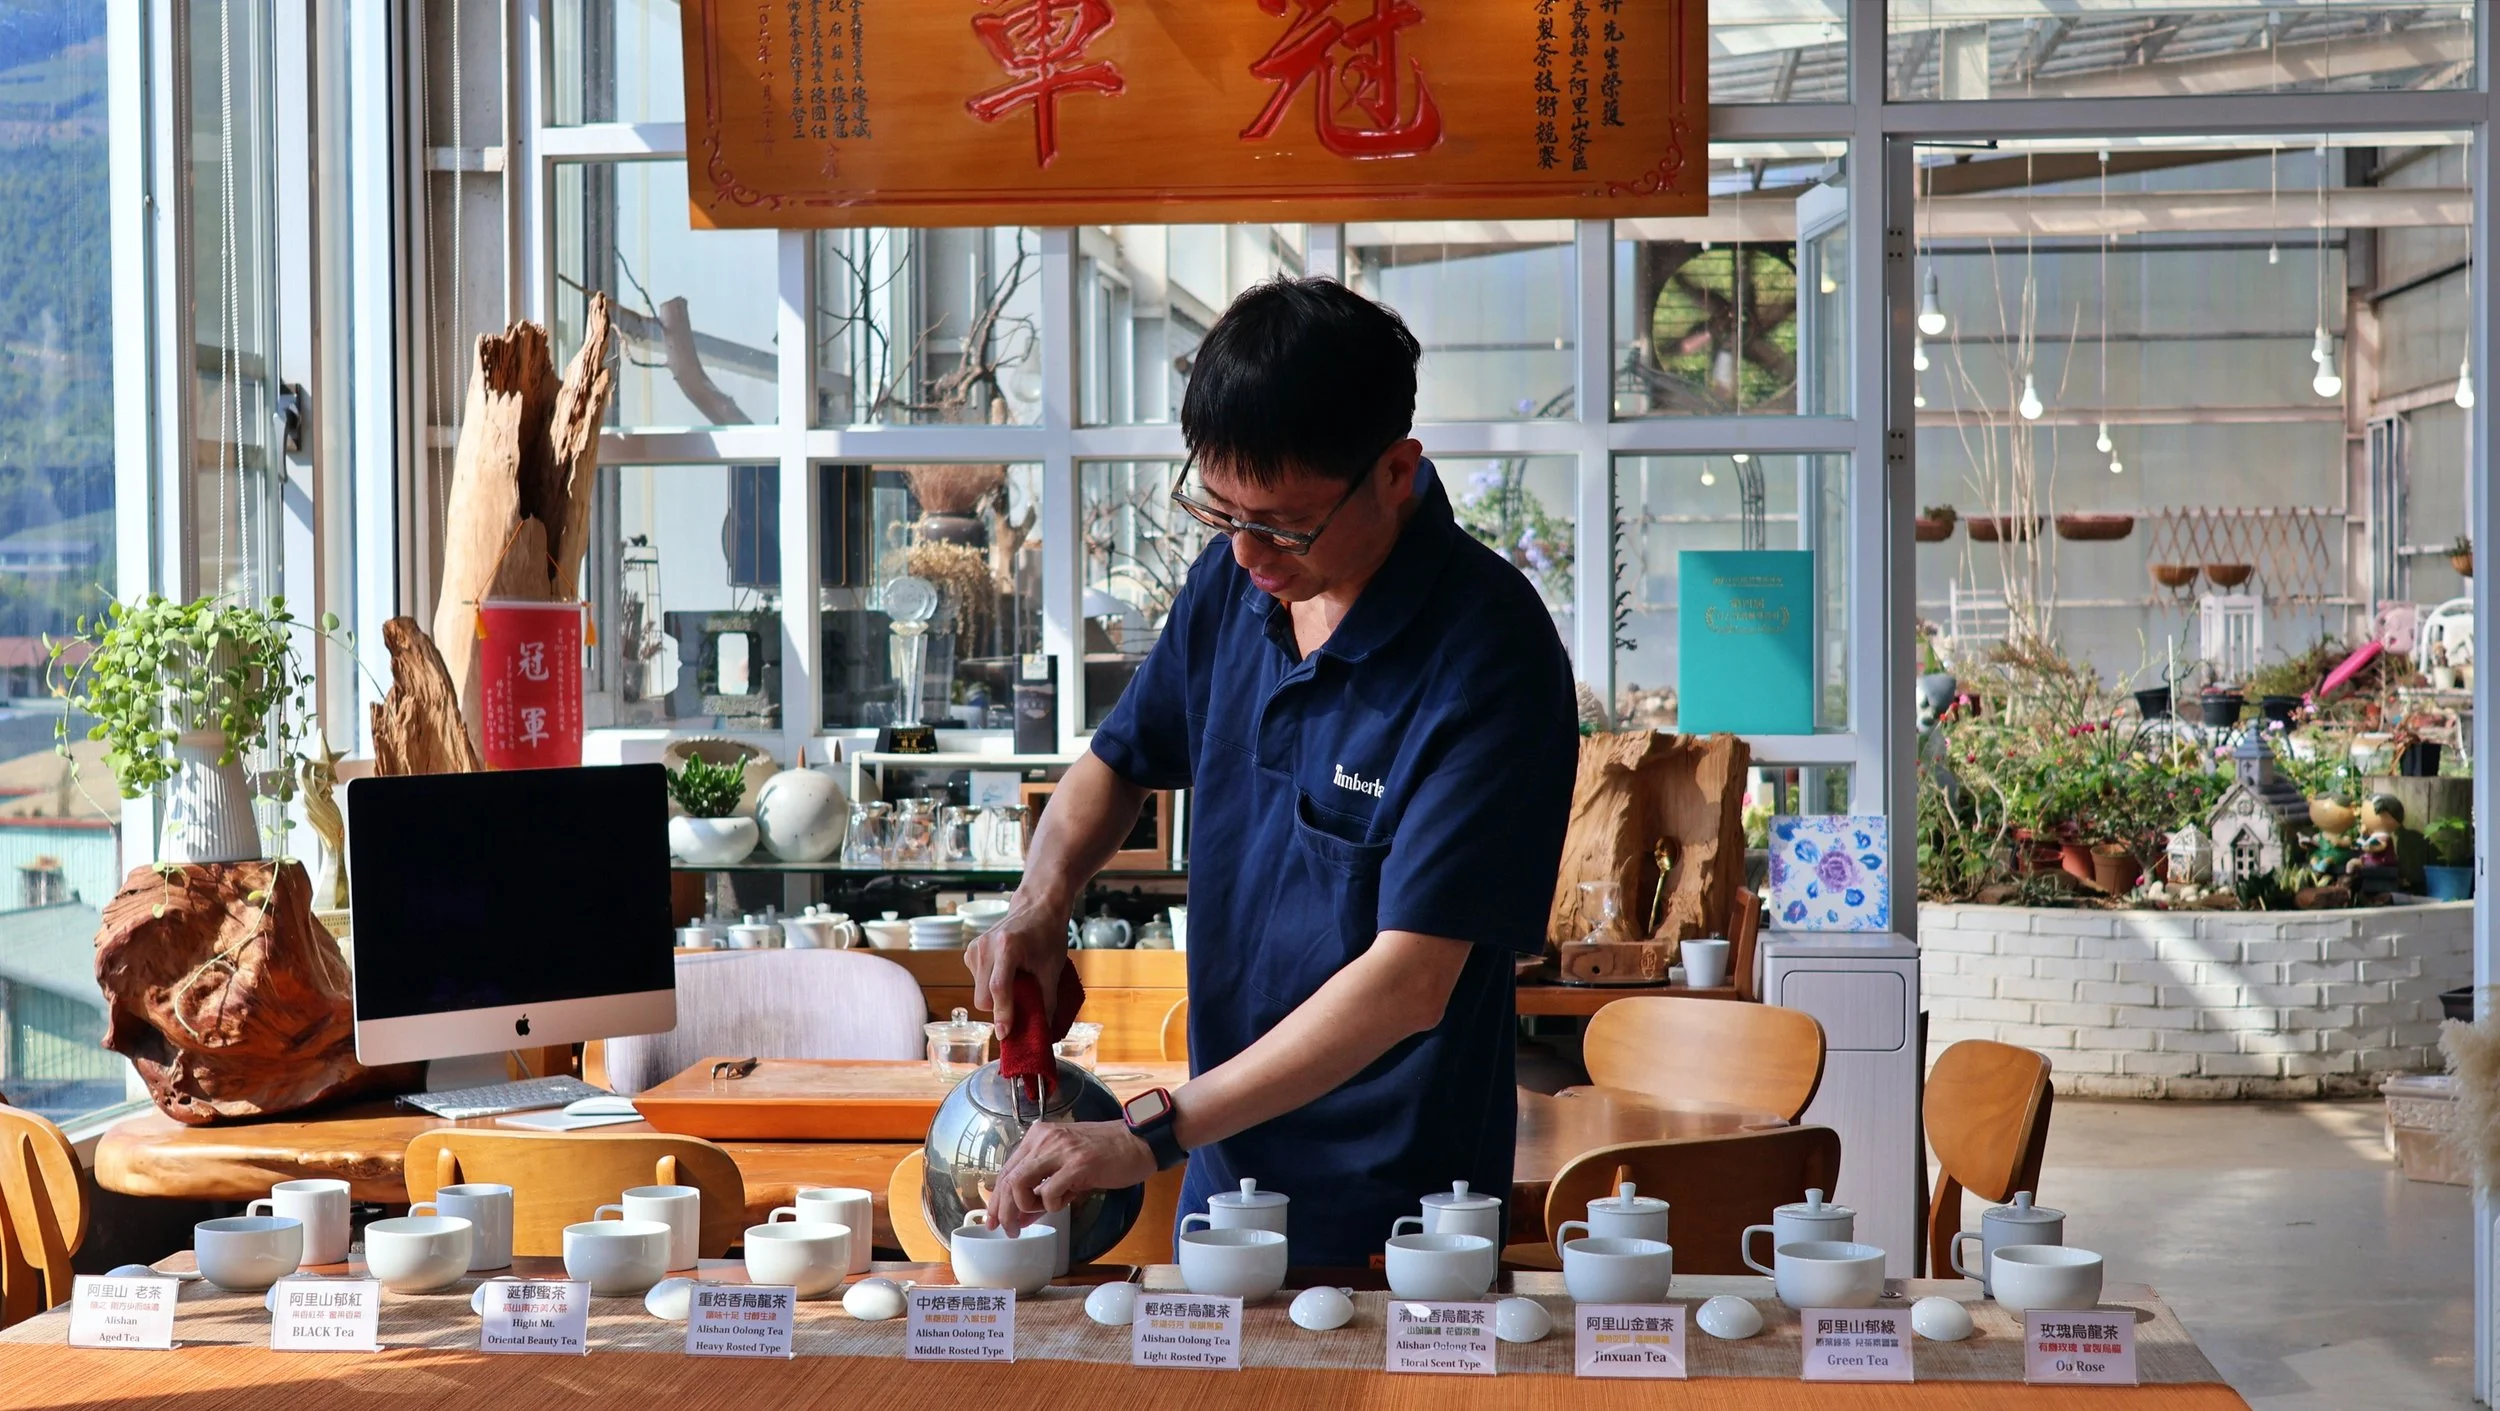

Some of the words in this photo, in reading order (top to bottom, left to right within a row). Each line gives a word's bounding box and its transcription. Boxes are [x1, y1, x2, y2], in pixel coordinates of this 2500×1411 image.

[517, 641, 550, 749] 冠軍
[1333, 763, 1385, 798] Timberla
[87, 1283, 128, 1298] 阿里山
[135, 1285, 163, 1300] 老茶
[289, 1292, 363, 1307] 阿里山郁紅
[698, 1292, 788, 1309] 重焙香烏龍茶
[916, 1296, 1006, 1311] 中焙香烏龍茶
[1145, 1302, 1231, 1319] 輕焙香烏龍茶
[104, 1316, 138, 1325] Alishan
[512, 1318, 538, 1330] Hight
[540, 1319, 555, 1328] Mt.
[1586, 1316, 1674, 1332] 阿里山金萱茶
[1818, 1319, 1896, 1335] 阿里山郁綠
[99, 1332, 122, 1343] Aged
[123, 1334, 140, 1342] Tea
[292, 1326, 331, 1337] BLACK
[333, 1327, 354, 1337] Tea
[696, 1325, 730, 1334] Alishan
[732, 1326, 765, 1337] Oolong
[766, 1327, 784, 1336] Tea
[916, 1329, 950, 1338] Alishan
[952, 1329, 985, 1340] Oolong
[987, 1329, 1004, 1338] Tea
[2040, 1323, 2119, 1340] 玫瑰烏龍茶
[488, 1335, 525, 1345] Oriental
[527, 1336, 559, 1347] Beauty
[560, 1337, 577, 1345] Tea
[1141, 1334, 1176, 1343] Alishan
[1178, 1335, 1212, 1347] Oolong
[1213, 1336, 1231, 1346] Tea
[1396, 1341, 1431, 1350] Alishan
[1433, 1341, 1467, 1352] Oolong
[1469, 1342, 1486, 1351] Tea
[696, 1341, 724, 1353] Heavy
[726, 1342, 757, 1352] Rosted
[759, 1344, 781, 1355] Type
[914, 1346, 946, 1355] Middle
[948, 1346, 980, 1355] Rosted
[982, 1346, 1004, 1358] Type
[1143, 1351, 1167, 1362] Light
[1170, 1352, 1202, 1362] Rosted
[1203, 1353, 1227, 1365] Type
[1593, 1351, 1642, 1363] Jinxuan
[1644, 1351, 1667, 1363] Tea
[1827, 1354, 1863, 1366] Green
[1866, 1355, 1889, 1366] Tea
[1401, 1358, 1428, 1367] Floral
[1430, 1359, 1456, 1368] Scent
[1458, 1359, 1481, 1371] Type
[2076, 1360, 2105, 1372] Rose
